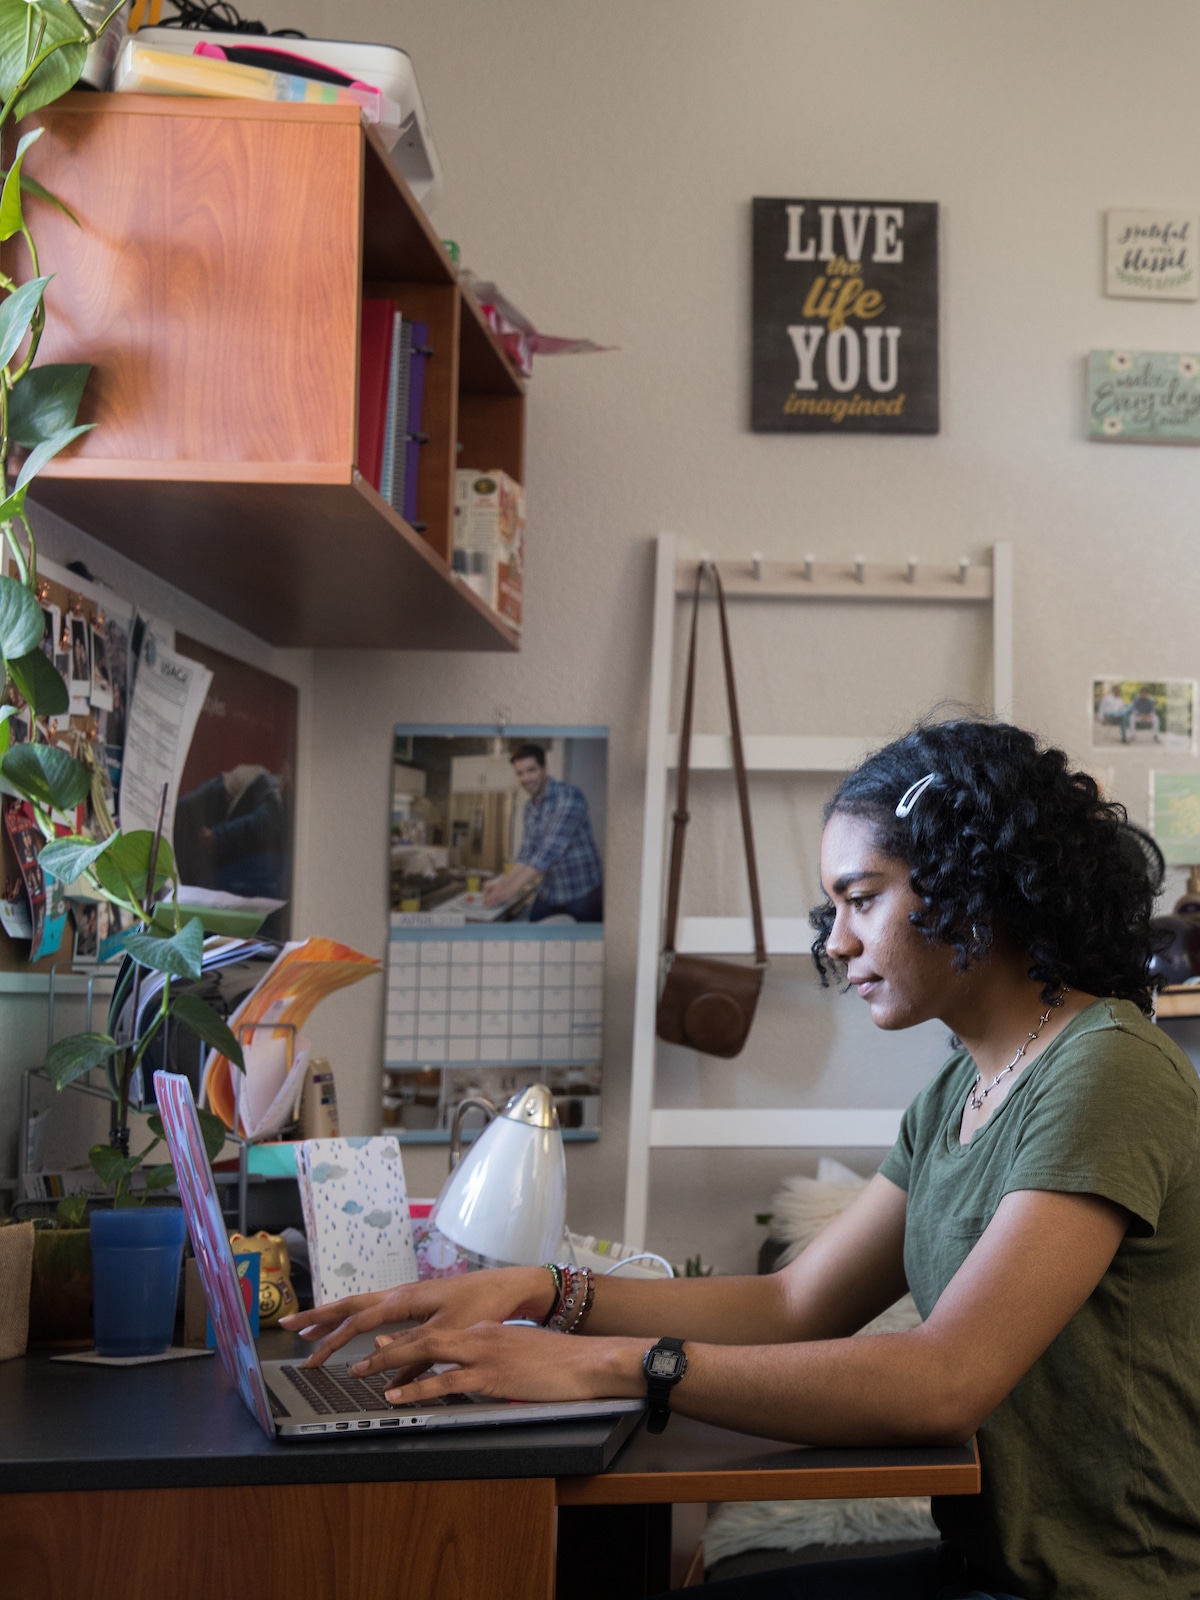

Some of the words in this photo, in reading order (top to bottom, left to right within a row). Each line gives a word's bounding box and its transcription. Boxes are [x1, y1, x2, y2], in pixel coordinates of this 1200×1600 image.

[785, 205, 904, 263] LIVE
[1123, 247, 1187, 272] blessed
[802, 276, 887, 333] life
[786, 325, 902, 393] YOU
[783, 393, 905, 424] imagined
